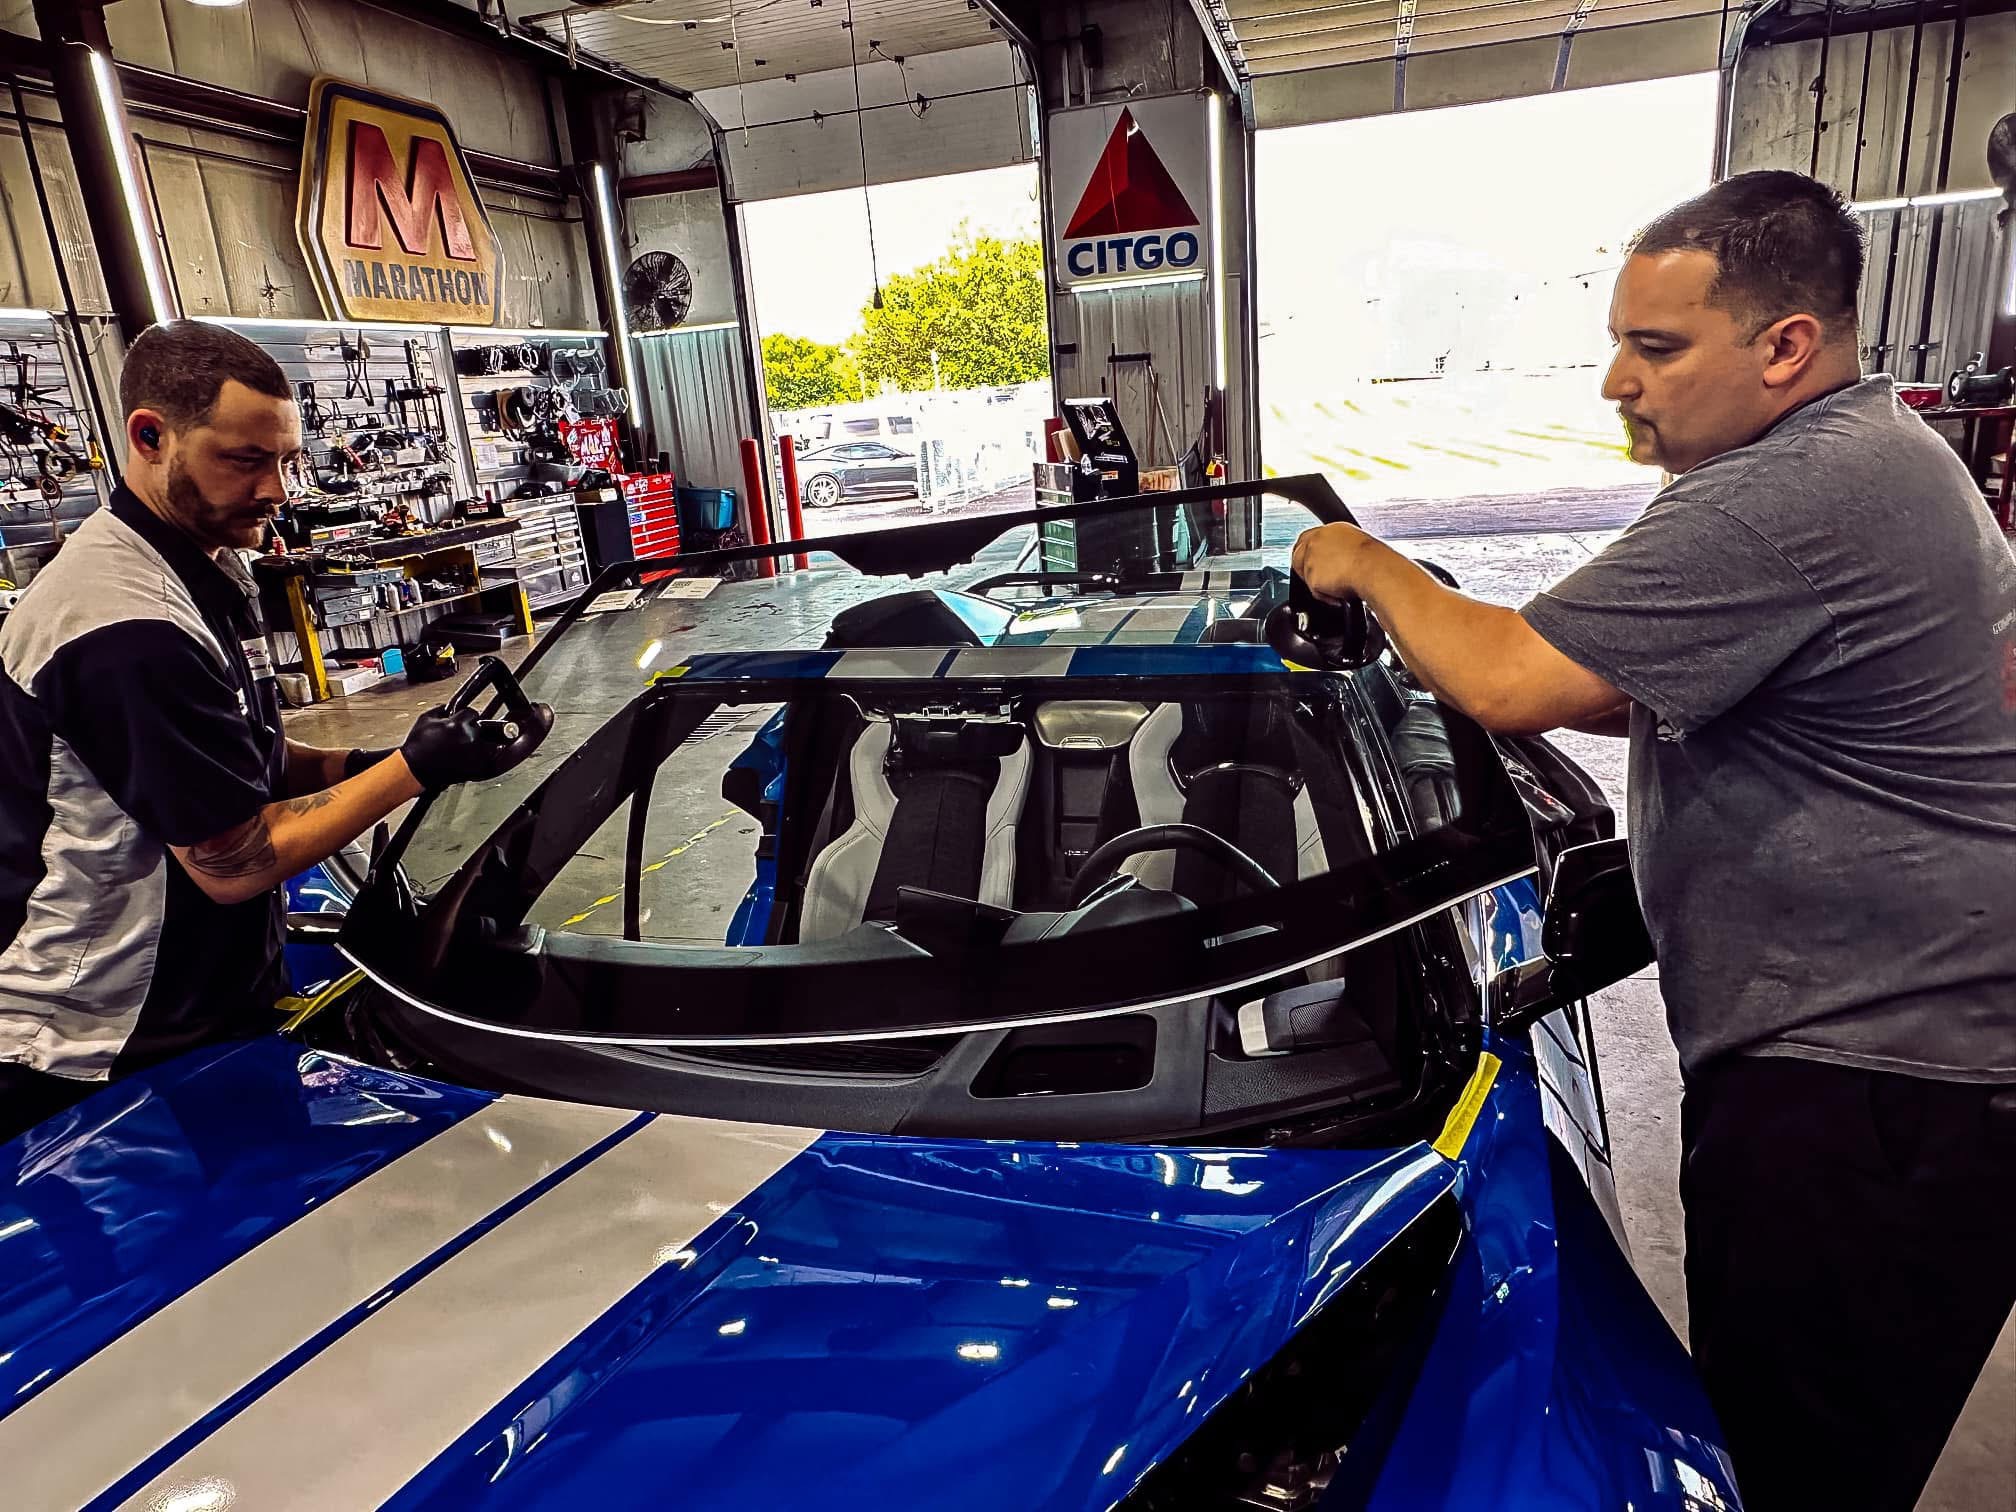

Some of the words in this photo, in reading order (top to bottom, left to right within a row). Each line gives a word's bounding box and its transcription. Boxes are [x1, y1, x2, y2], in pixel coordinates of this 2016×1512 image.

[345, 119, 477, 262] M
[1067, 231, 1199, 277] CITGO
[343, 259, 489, 306] MARATHON
